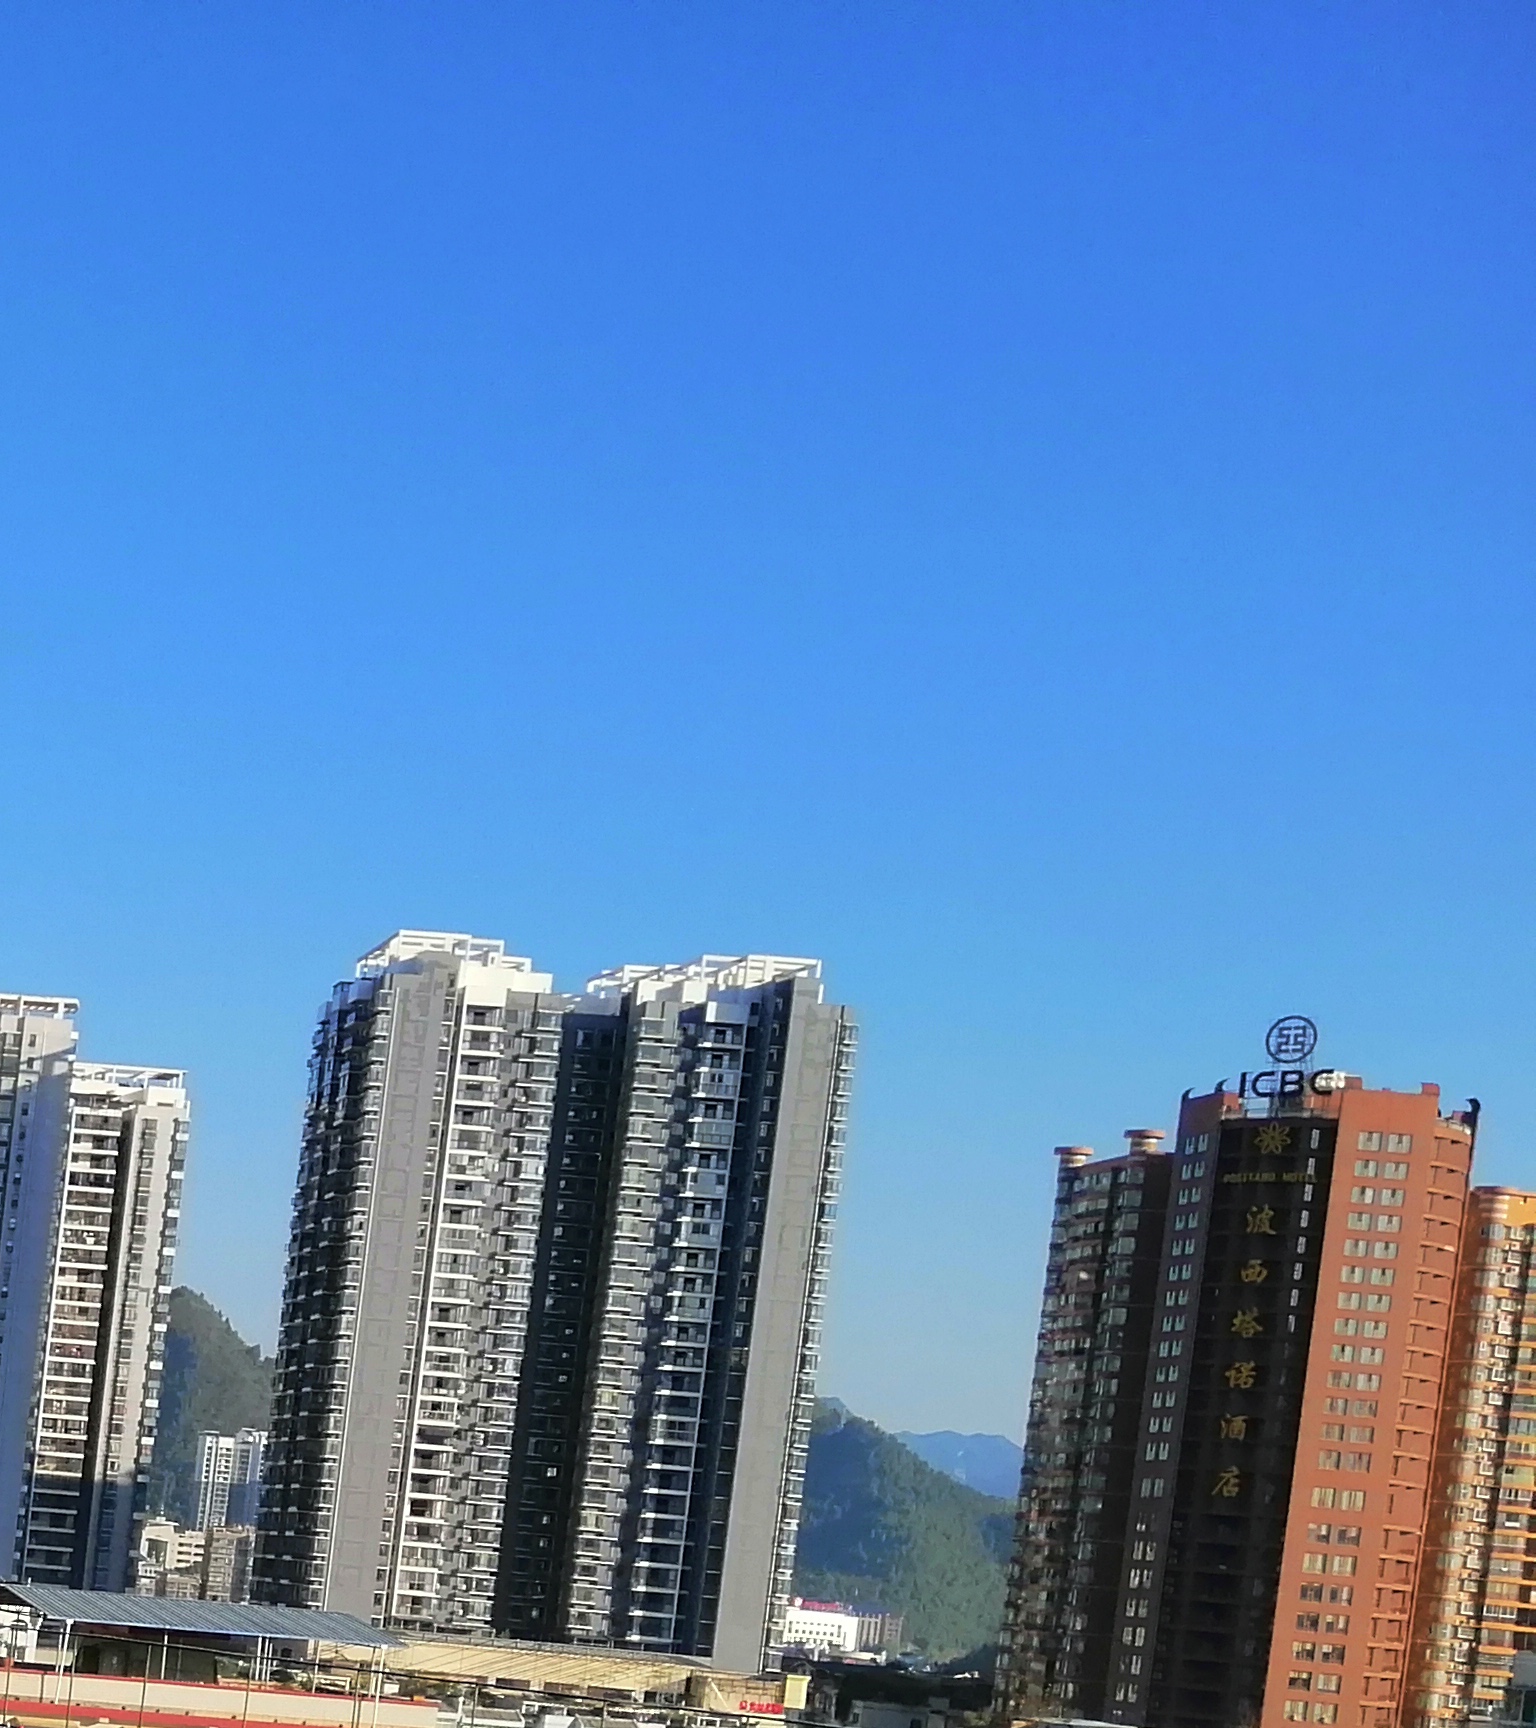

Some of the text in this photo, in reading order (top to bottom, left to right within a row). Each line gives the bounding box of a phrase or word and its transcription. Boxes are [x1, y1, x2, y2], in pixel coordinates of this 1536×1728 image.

[1238, 1069, 1335, 1097] ICBC
[1211, 1204, 1277, 1498] 波西塔诺酒店
